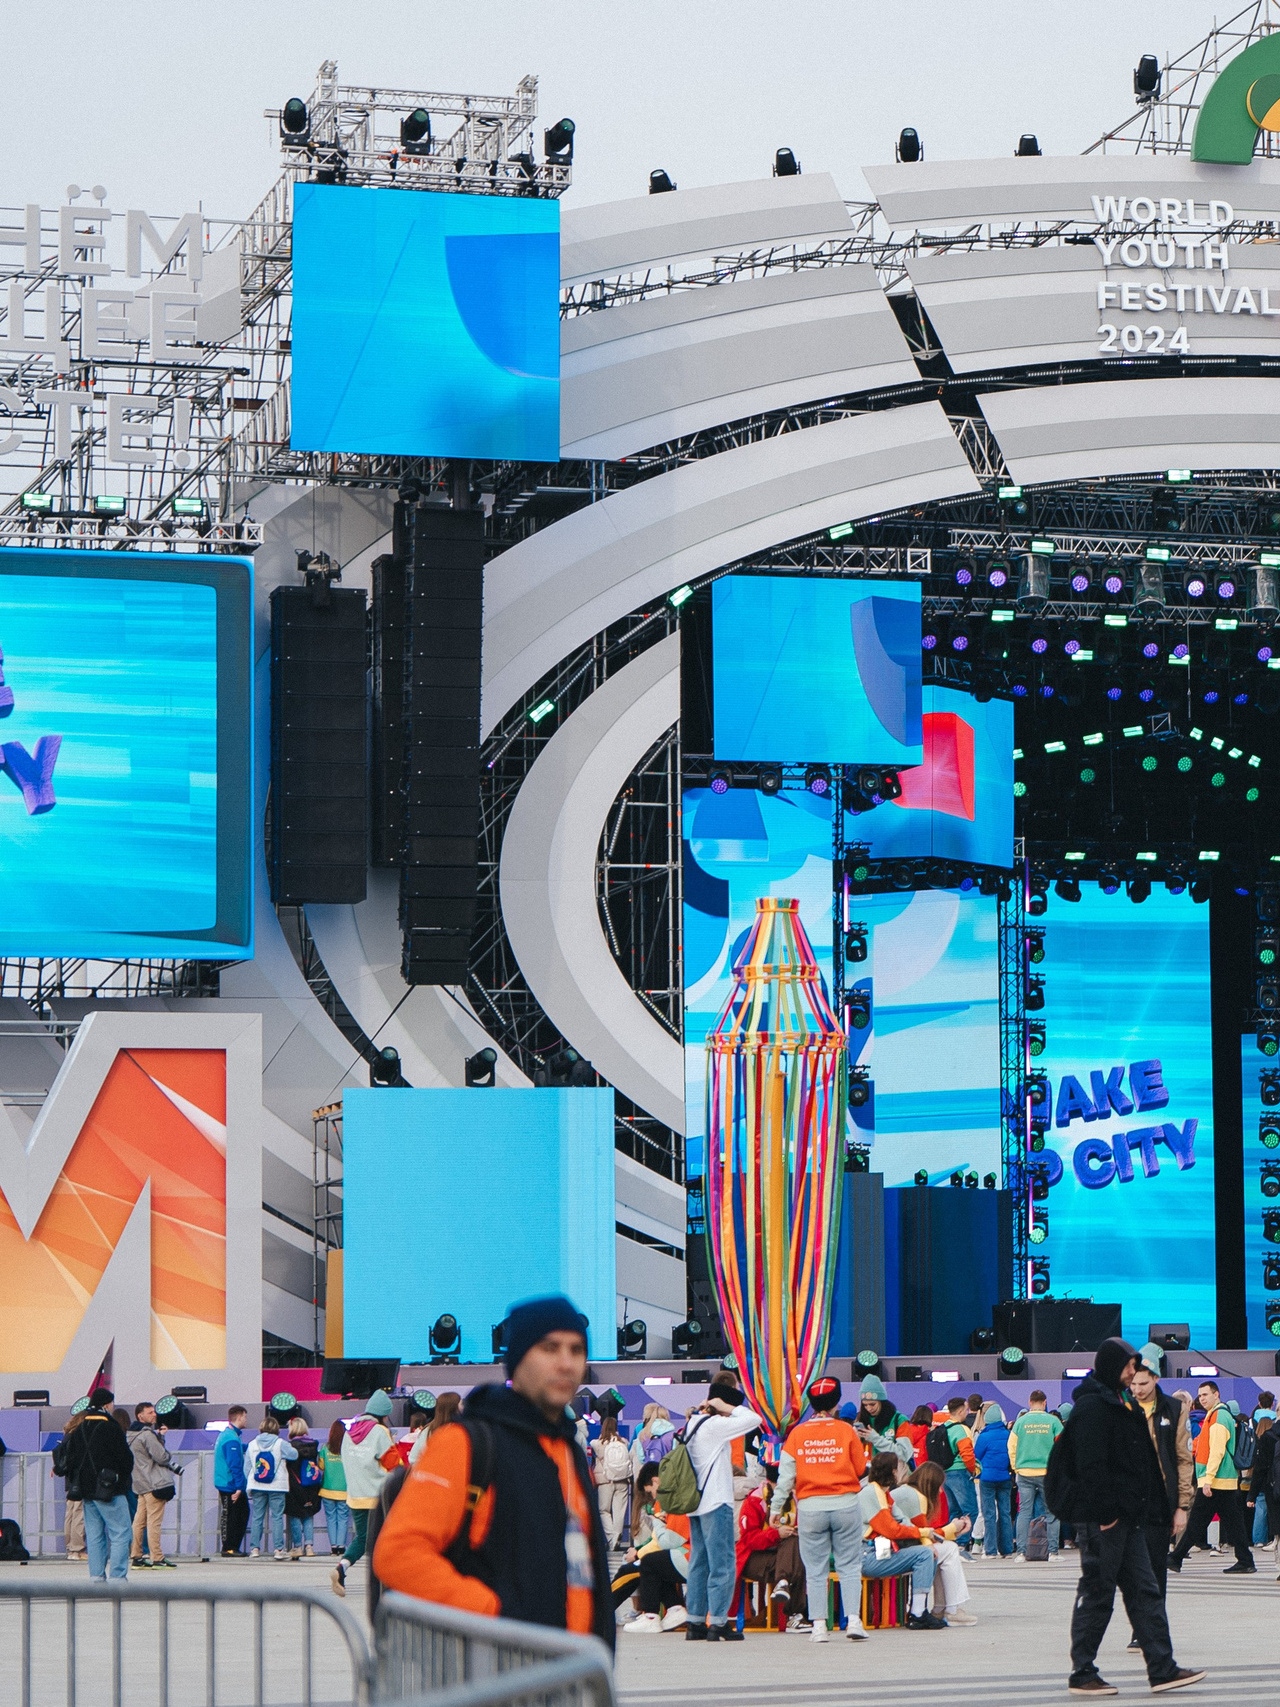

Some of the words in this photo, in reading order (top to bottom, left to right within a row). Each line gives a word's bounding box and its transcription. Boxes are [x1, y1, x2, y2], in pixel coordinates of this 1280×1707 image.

[1091, 195, 1235, 228] WORLD
[1093, 237, 1230, 270] YOUTH
[1097, 323, 1190, 355] 2024
[1073, 1118, 1199, 1190] CITY
[797, 1448, 804, 1456] В
[805, 1447, 843, 1456] КАЖДОМ
[803, 1439, 836, 1448] СМЫСЛ
[805, 1456, 817, 1464] ИЗ
[818, 1455, 836, 1463] НАС
